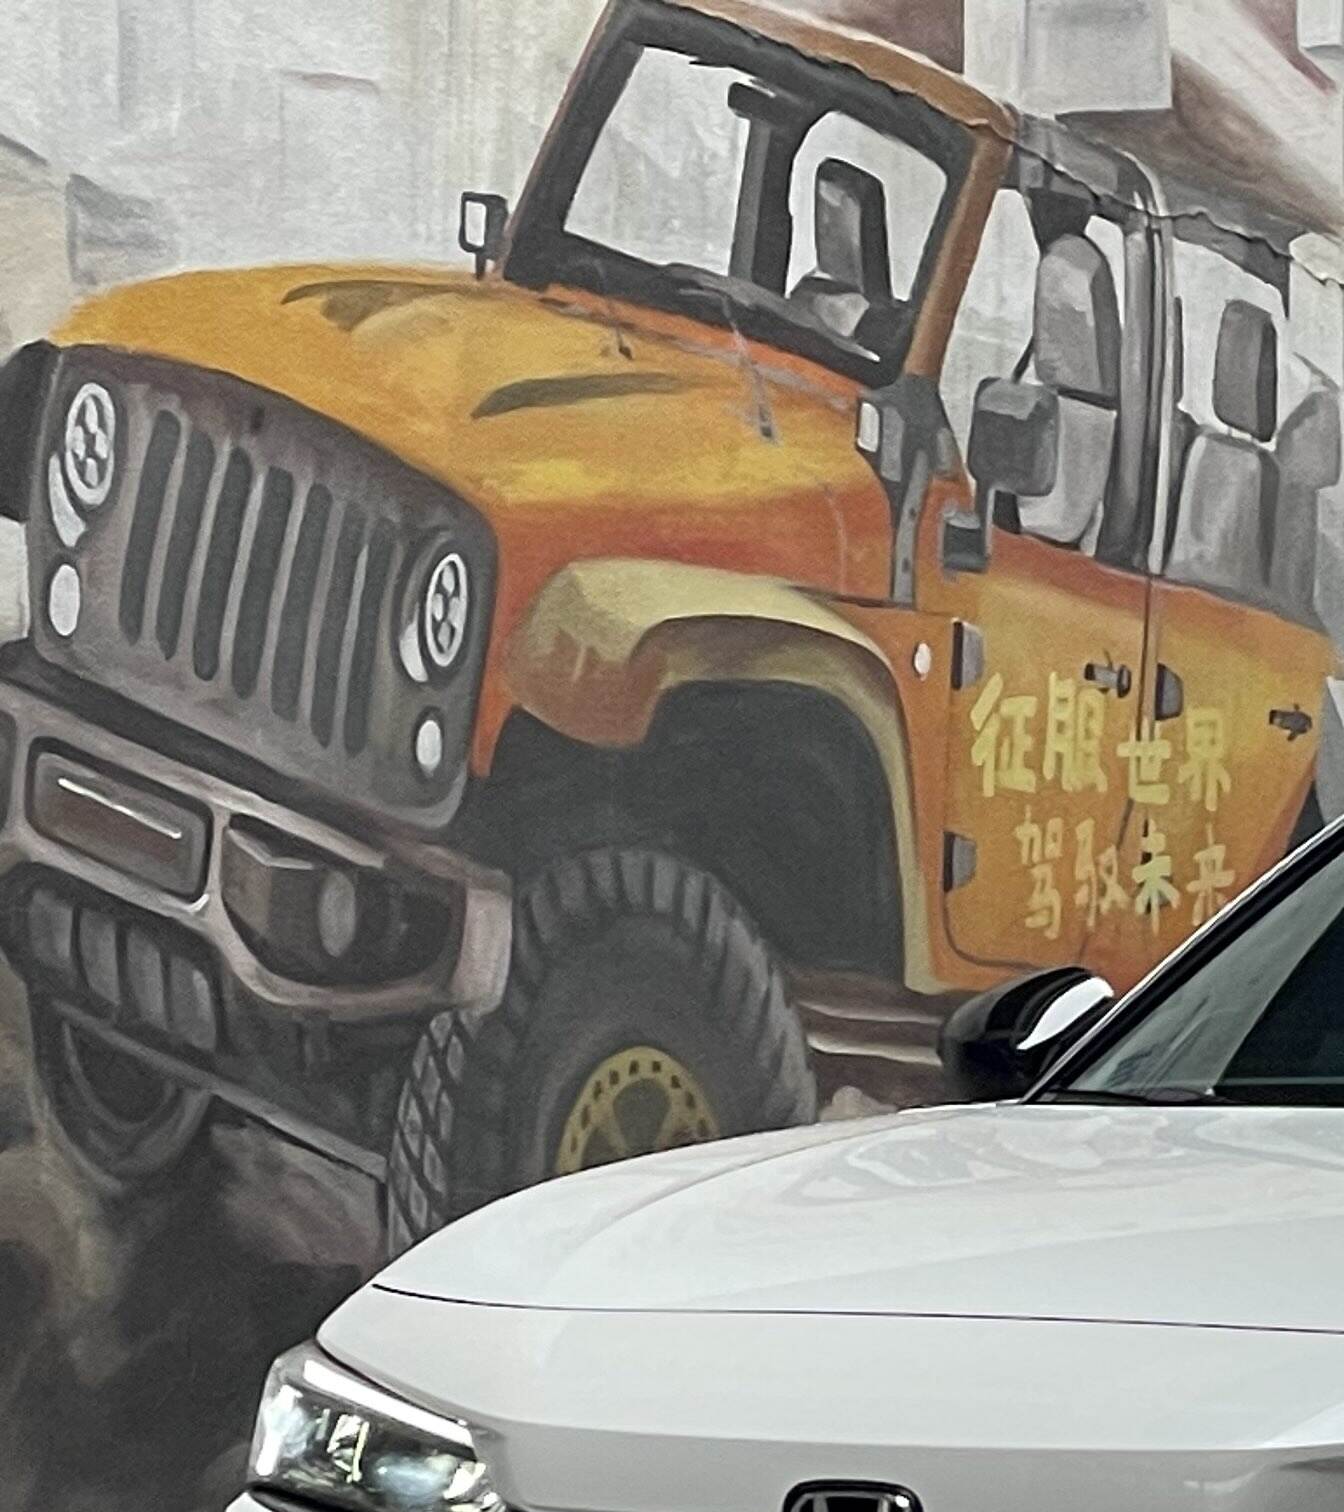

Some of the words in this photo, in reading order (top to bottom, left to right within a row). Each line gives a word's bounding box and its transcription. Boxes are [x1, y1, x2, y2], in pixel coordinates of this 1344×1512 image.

[970, 672, 1232, 811] 征服世界
[1014, 804, 1237, 937] 驾驭未来
